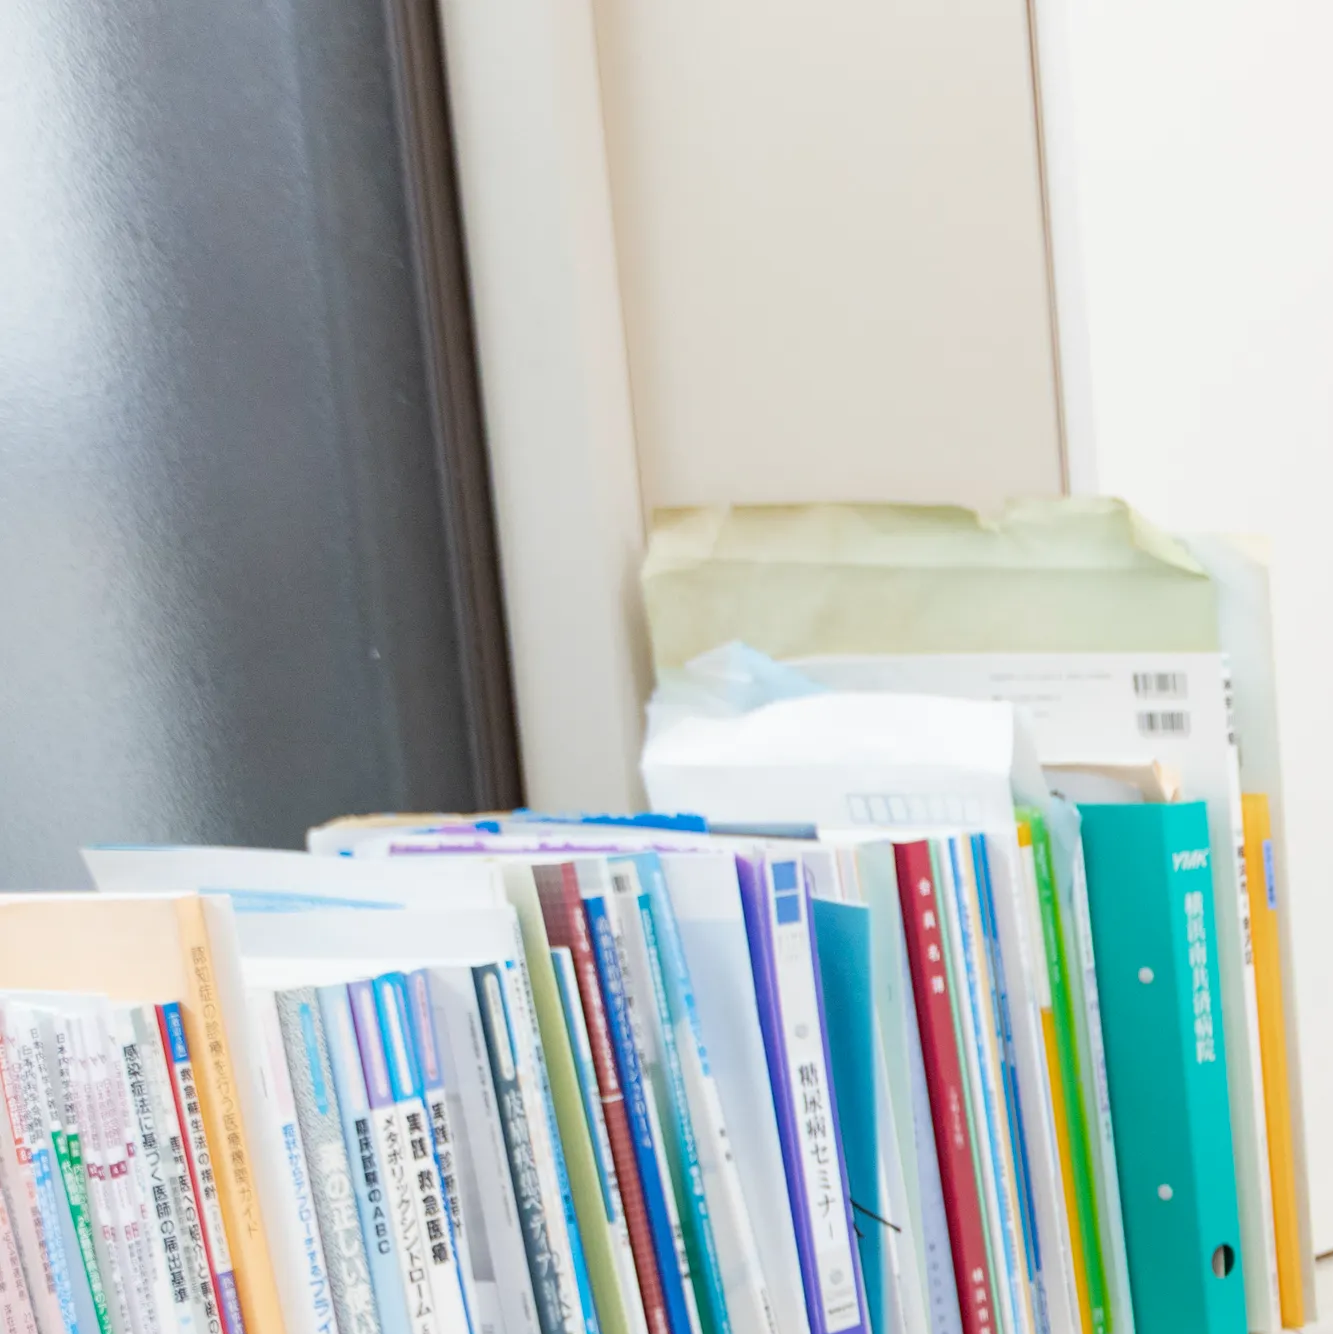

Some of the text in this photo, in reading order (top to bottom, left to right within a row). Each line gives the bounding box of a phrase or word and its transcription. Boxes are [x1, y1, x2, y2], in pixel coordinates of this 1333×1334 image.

[1184, 890, 1217, 1064] 横浜南共済病院
[382, 1114, 433, 1320] メタボリックシンドローム
[405, 1110, 450, 1265] 実践 救急医療
[797, 1064, 836, 1240] 糖尿病セミナー
